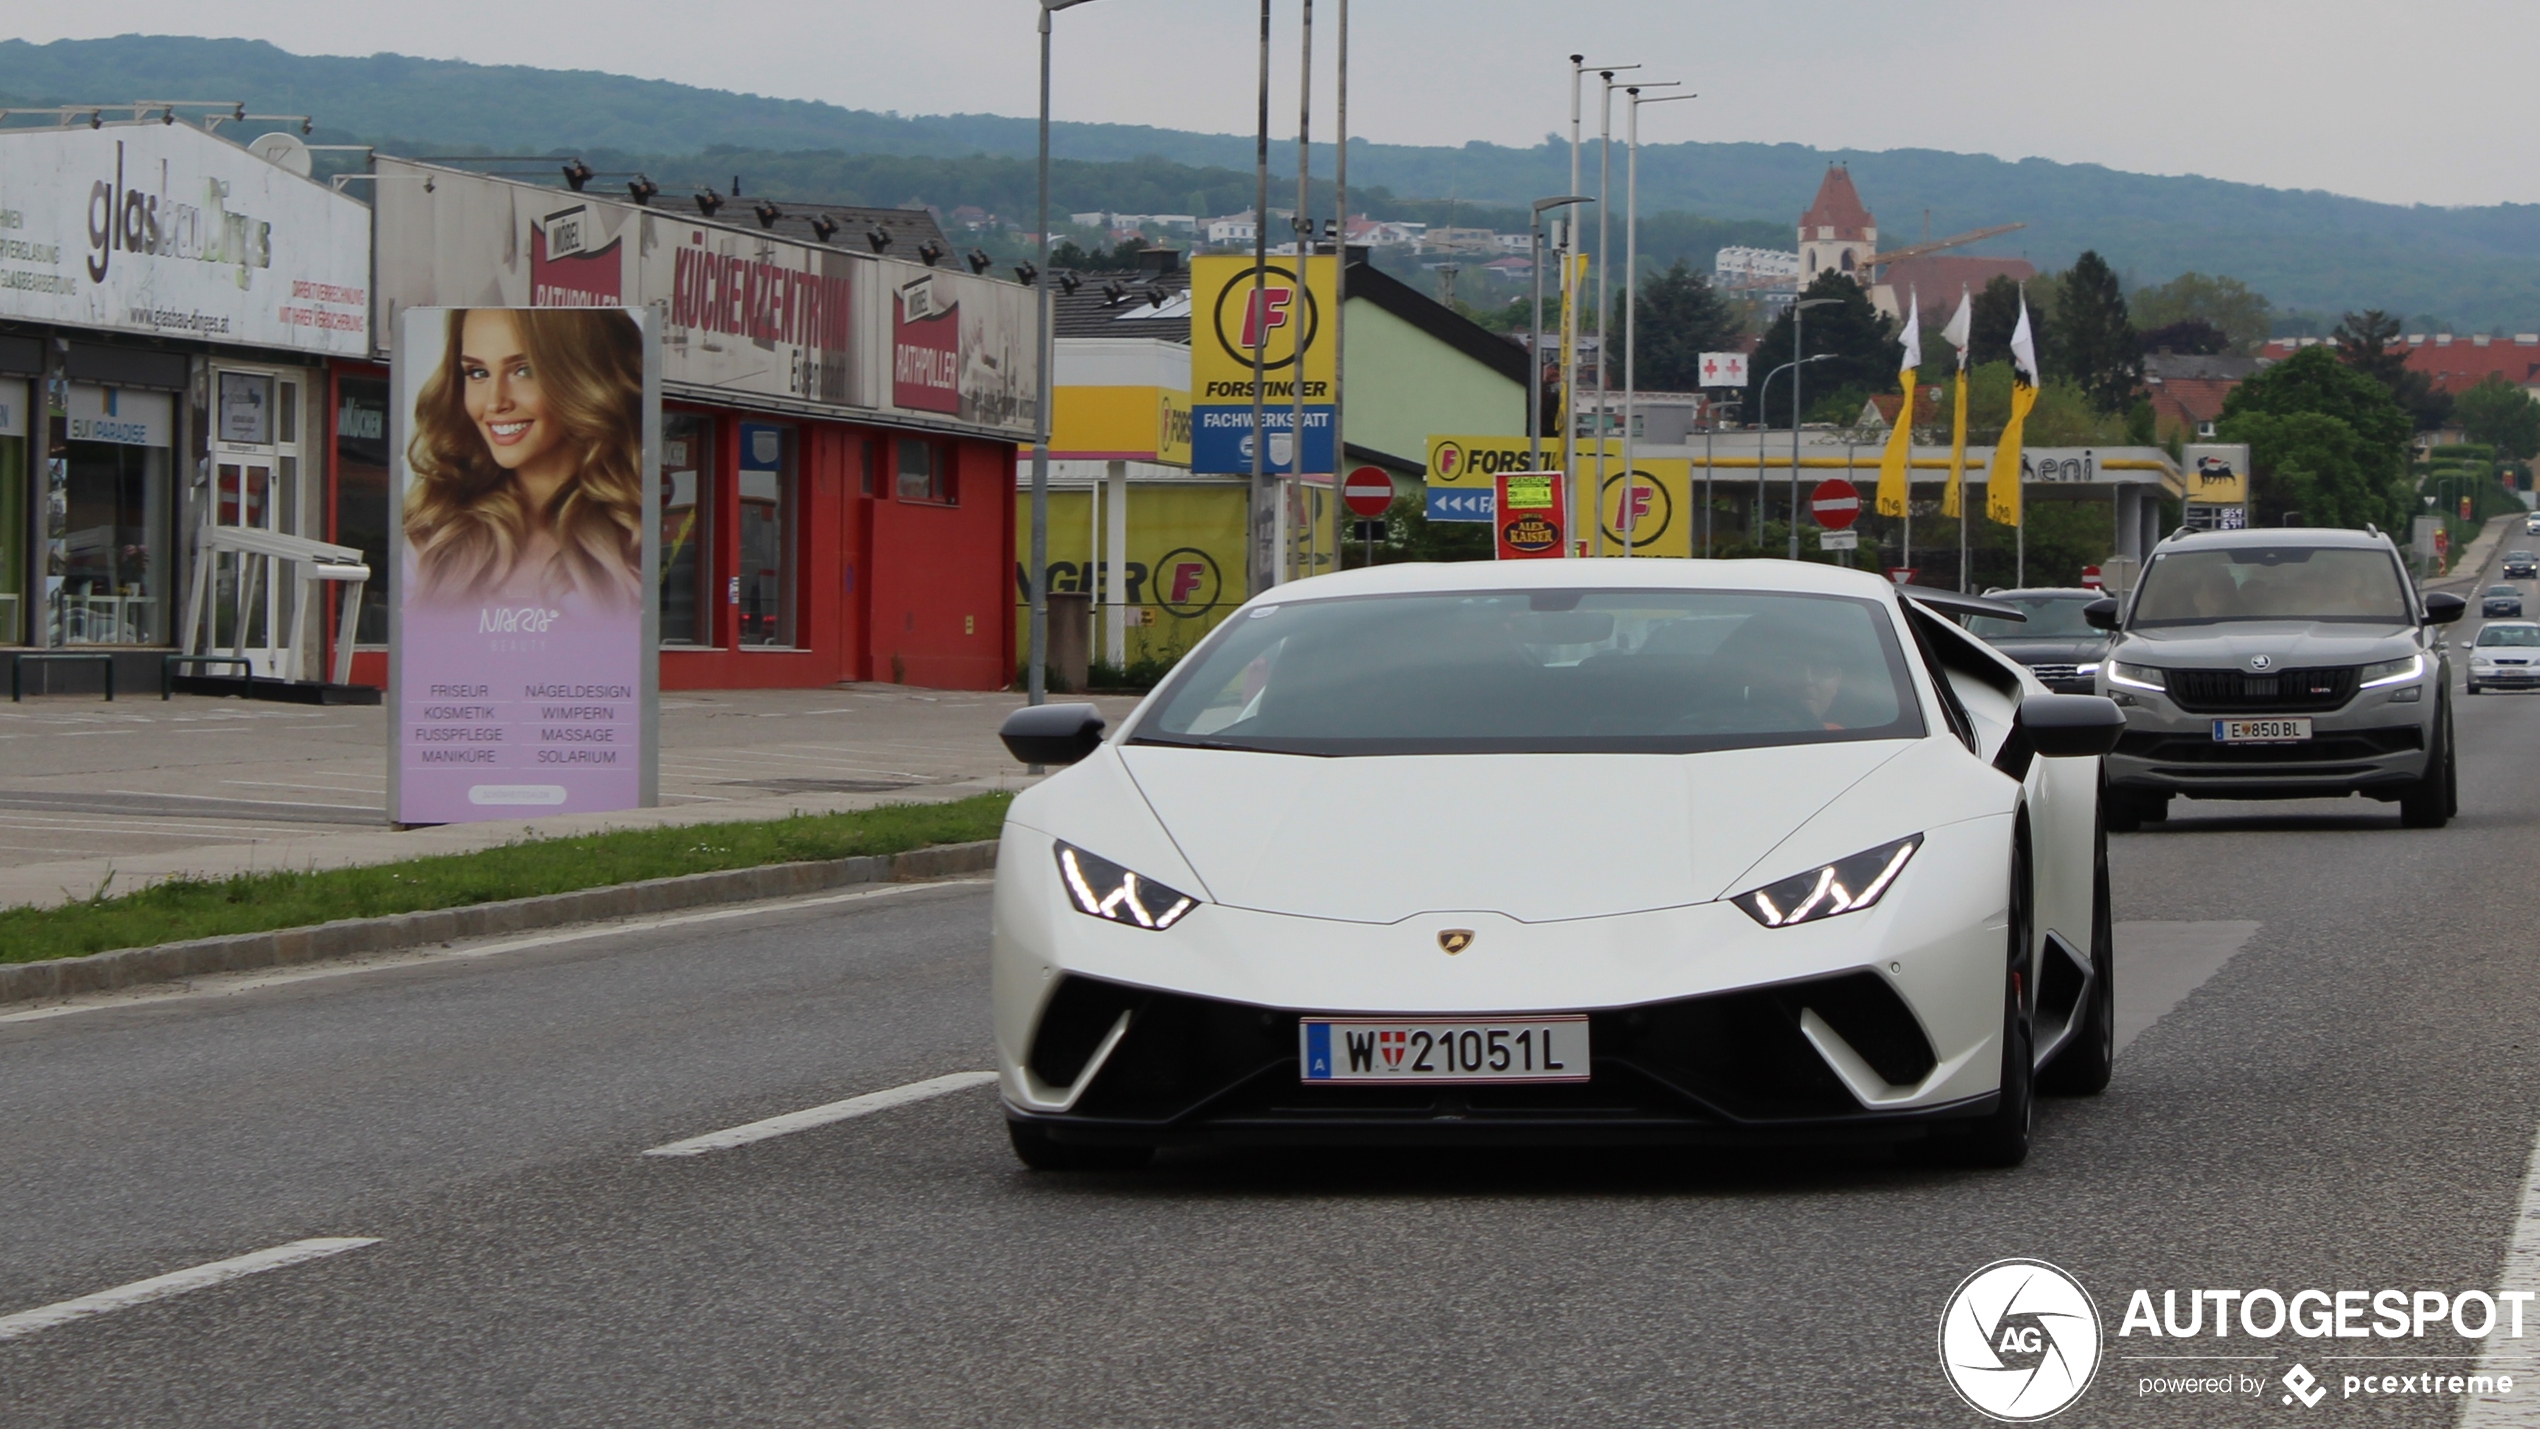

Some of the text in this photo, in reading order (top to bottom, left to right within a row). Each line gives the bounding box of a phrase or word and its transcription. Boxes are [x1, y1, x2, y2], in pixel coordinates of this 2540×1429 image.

[671, 231, 851, 354] KÜCHENZENTRUM
[1240, 287, 1292, 348] F
[1203, 413, 1330, 428] FACHWERKSATT
[2038, 450, 2092, 482] eni
[1518, 522, 1545, 532] ALEX
[1510, 529, 1554, 543] KAISER
[1171, 562, 1205, 604] F
[430, 684, 489, 698] FRISEUR
[525, 683, 632, 698] NÄGELDESIGN
[424, 706, 495, 720] KOSMETIK
[541, 707, 614, 720] WIMPERN
[415, 728, 503, 741] FUSSPFLEGE
[541, 729, 614, 742] MASSAGE
[2232, 723, 2241, 737] E
[2252, 722, 2279, 737] 850
[2283, 722, 2300, 737] BL
[421, 749, 496, 763] MANIKÜRE
[537, 750, 616, 764] SOLARIUM
[1313, 1058, 1325, 1071] A
[1346, 1030, 1375, 1072] W
